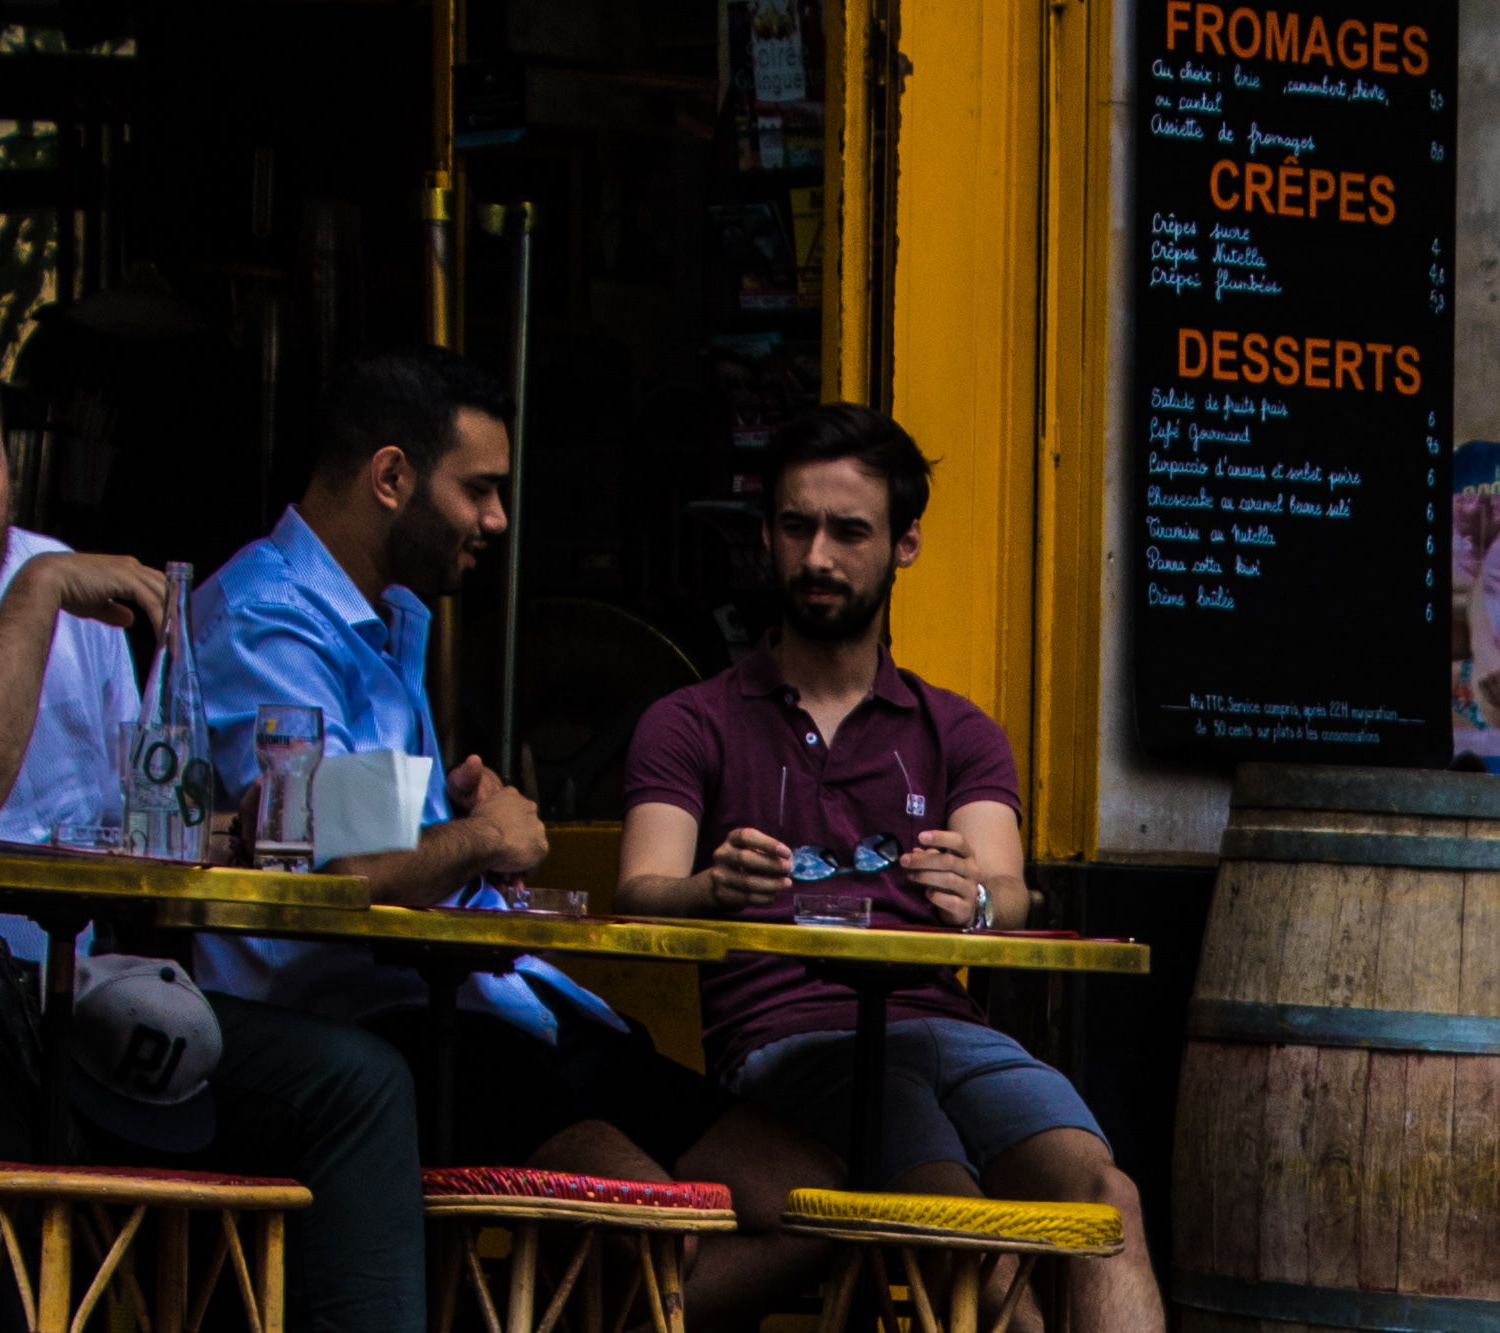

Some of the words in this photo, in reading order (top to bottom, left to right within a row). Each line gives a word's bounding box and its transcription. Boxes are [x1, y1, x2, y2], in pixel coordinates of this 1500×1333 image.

[1166, 0, 1430, 76] FROMAGES
[1152, 58, 1174, 81] Au
[1233, 63, 1261, 89] brie
[1155, 93, 1173, 109] ou
[1178, 90, 1223, 114] cantal
[1150, 113, 1204, 139] Assiette
[1218, 121, 1235, 144] de
[1247, 120, 1317, 157] fromages
[1209, 155, 1396, 226] CRÊPES
[1151, 212, 1197, 241] Crêpes
[1209, 222, 1251, 243] sucre
[1431, 237, 1442, 257] 4
[1151, 240, 1198, 268] Crêpes
[1212, 242, 1267, 268] Nutella
[1214, 269, 1283, 303] flambées
[1178, 327, 1422, 396] DESSERTS
[1151, 387, 1195, 411] Salade
[1204, 393, 1219, 413] de
[1223, 392, 1256, 422] fruits
[1260, 396, 1289, 423] frais
[1428, 409, 1436, 428] 6
[1149, 415, 1181, 451] Café
[1149, 450, 1209, 482] Carpaccio
[1215, 455, 1267, 479] d'ananas
[1270, 462, 1284, 480] et
[1285, 461, 1322, 484] sorbet
[1328, 466, 1362, 492] poire
[1426, 467, 1435, 488] 6
[1147, 484, 1214, 509] Cheesecake
[1220, 496, 1235, 512] au
[1238, 493, 1284, 515] caramel
[1325, 497, 1352, 520] salé
[1426, 501, 1435, 522] 6
[1146, 515, 1200, 542] Tiramisu
[1210, 528, 1225, 544] au
[1426, 534, 1435, 556] 6
[1146, 545, 1187, 572] Panna
[1191, 555, 1223, 575] cotta
[1235, 554, 1261, 577] kiwi
[1425, 567, 1434, 588] 6
[1148, 582, 1186, 608] Crème
[1196, 584, 1236, 612] brûlée
[1213, 718, 1226, 736] 50
[1329, 699, 1348, 719] 22H
